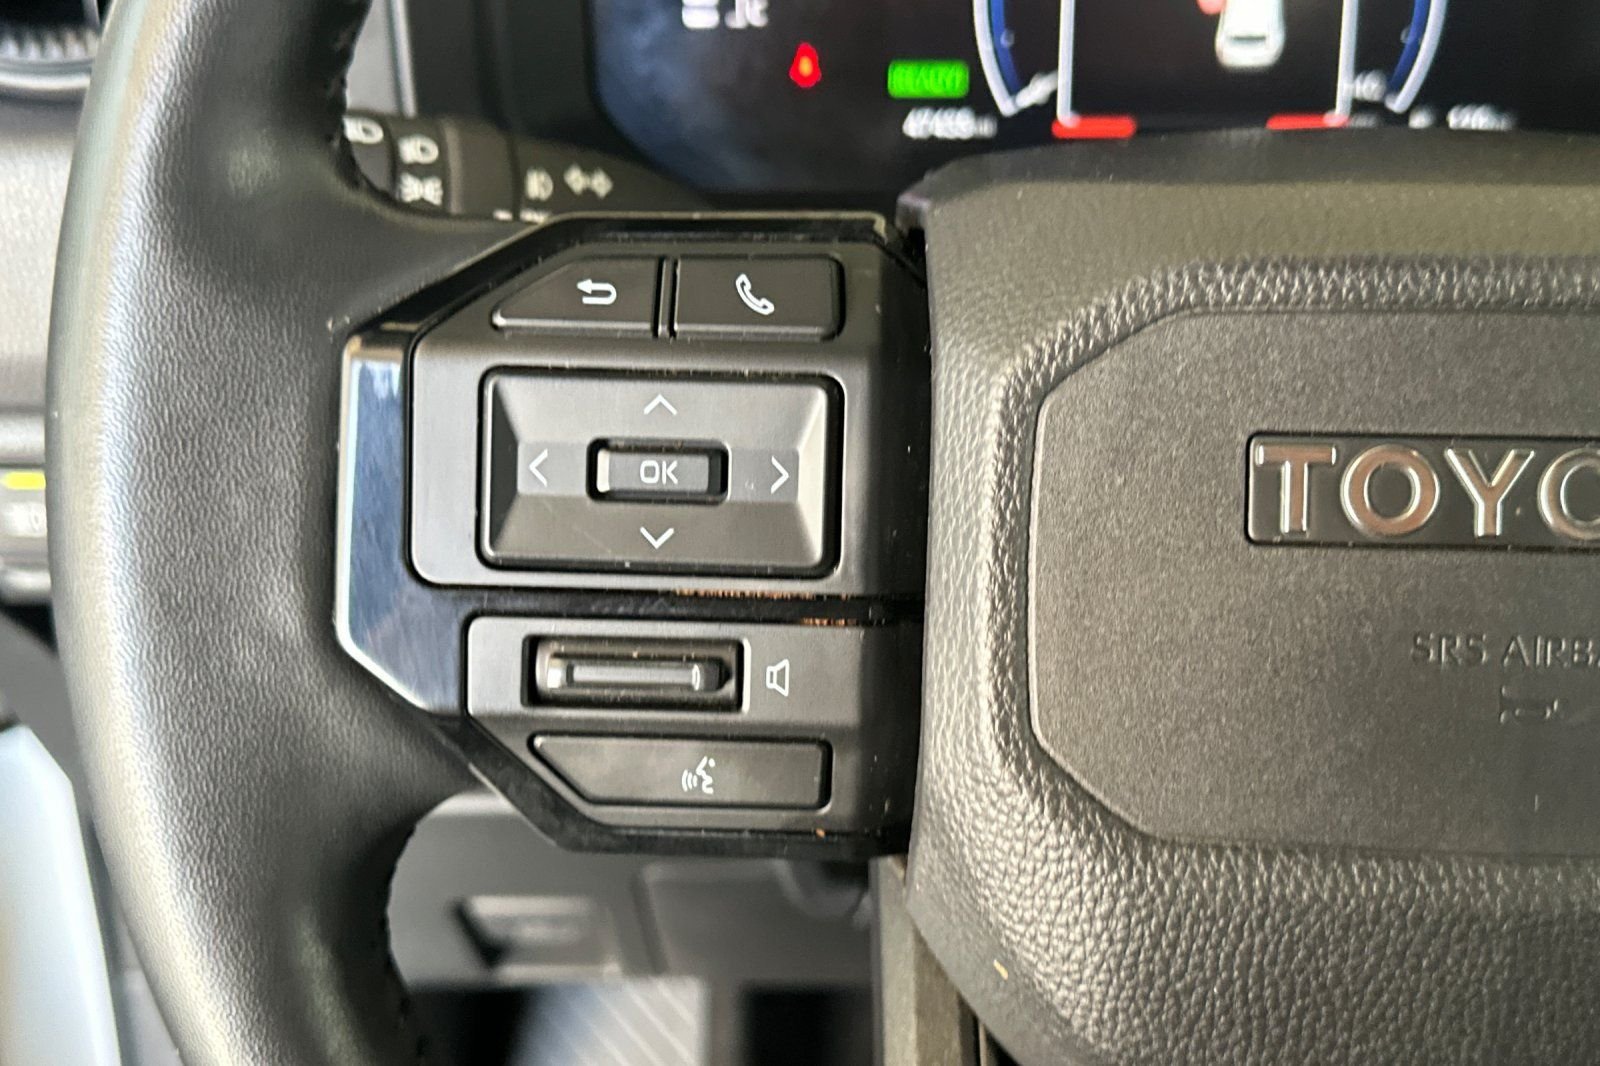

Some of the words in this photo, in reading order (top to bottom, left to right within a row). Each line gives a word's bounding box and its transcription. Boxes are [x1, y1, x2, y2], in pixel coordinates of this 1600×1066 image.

[640, 460, 678, 485] OK
[1411, 633, 1488, 666] SRS
[1502, 634, 1600, 668] AIRB
